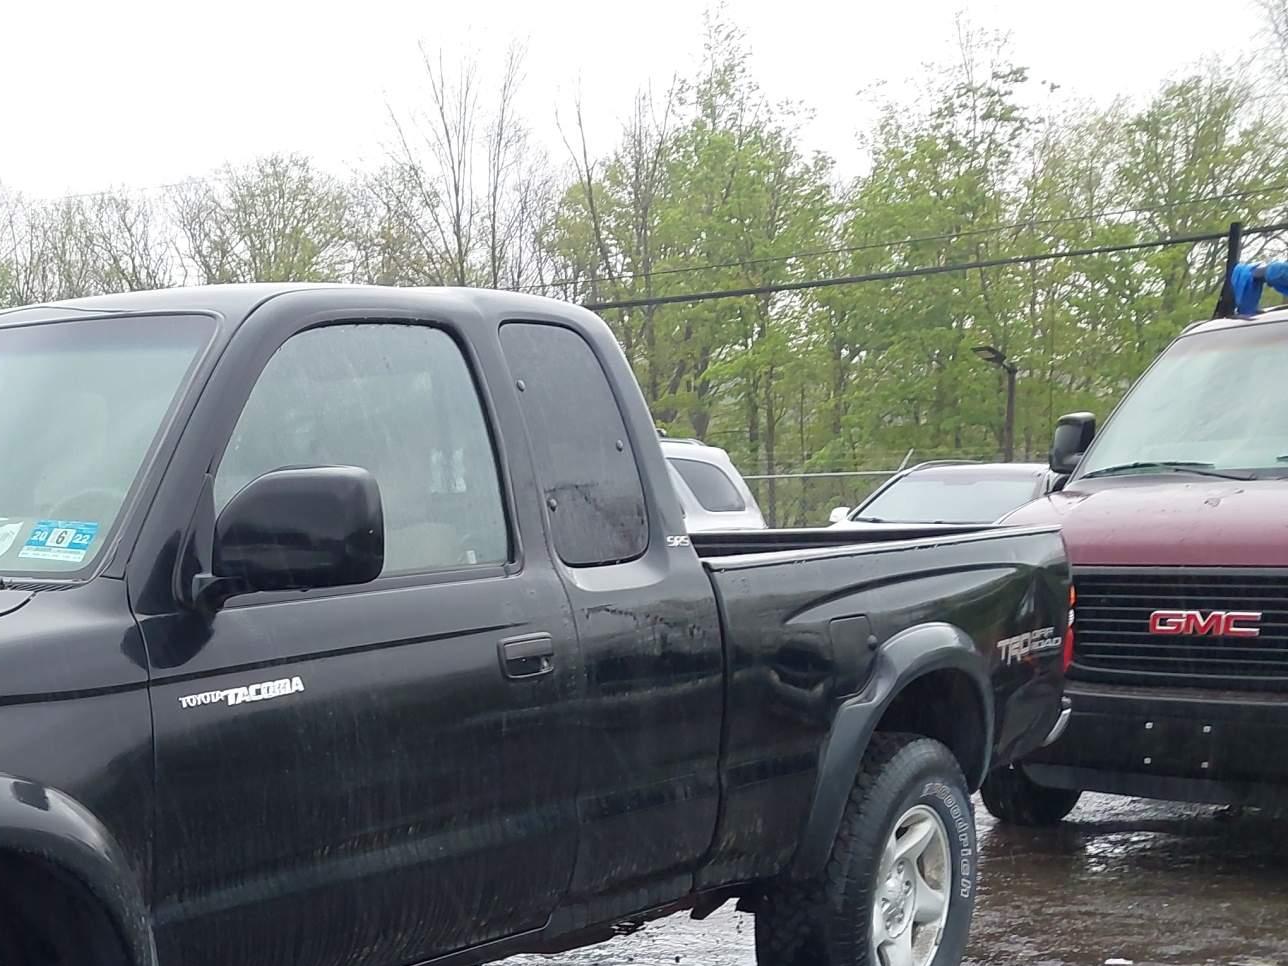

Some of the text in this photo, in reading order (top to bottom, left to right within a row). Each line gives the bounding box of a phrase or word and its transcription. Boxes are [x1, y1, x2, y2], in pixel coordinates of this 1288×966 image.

[55, 530, 68, 545] 6
[72, 533, 91, 545] 22
[1149, 610, 1263, 637] GMC
[996, 631, 1032, 665] TRD
[178, 676, 305, 708] TOYOTA TACOMA
